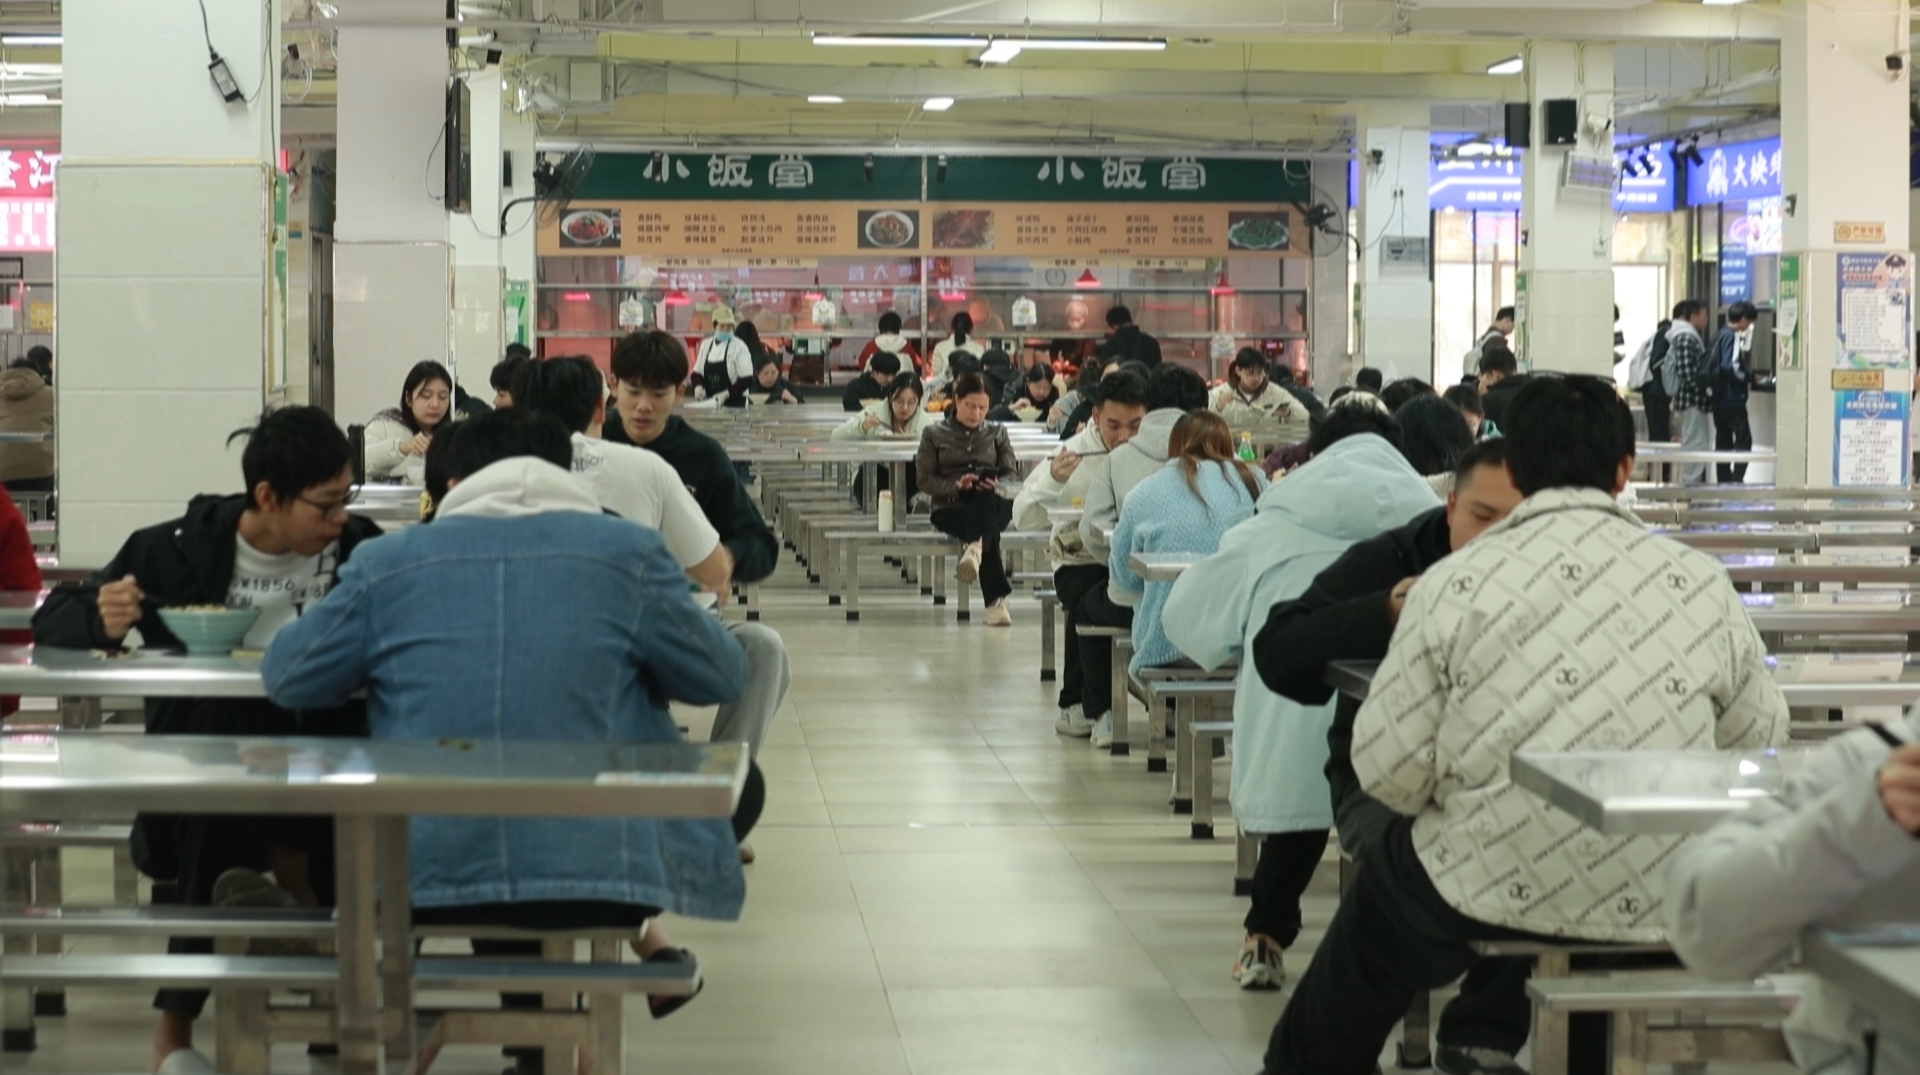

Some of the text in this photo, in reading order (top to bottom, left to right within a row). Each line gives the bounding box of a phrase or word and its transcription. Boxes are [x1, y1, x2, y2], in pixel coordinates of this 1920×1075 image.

[642, 153, 815, 189] 小饭堂
[1037, 155, 1207, 191] 小饭堂
[1066, 225, 1107, 234] 红烧肉
[697, 258, 712, 266] 10元
